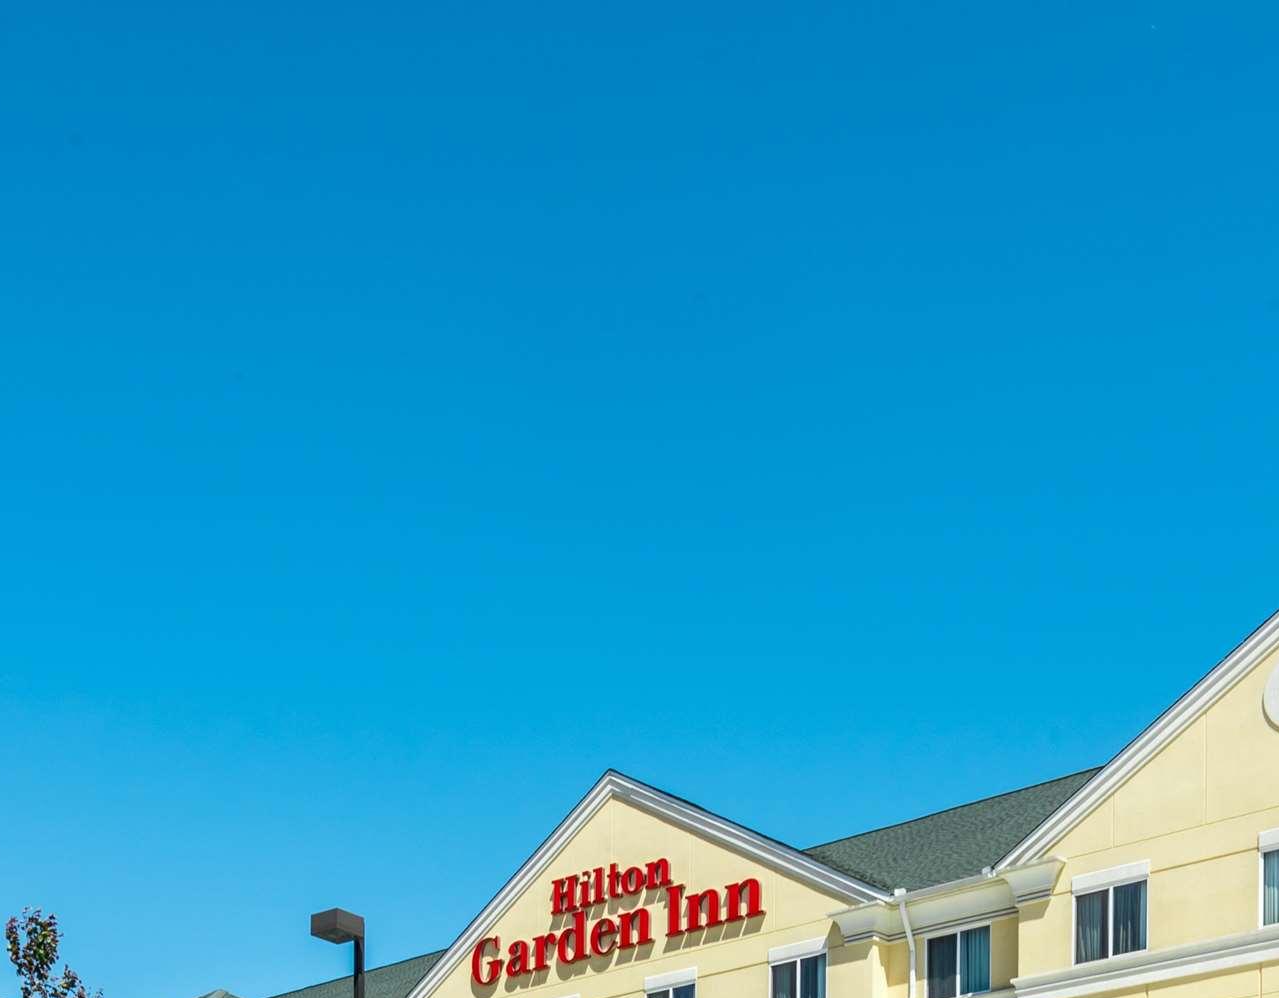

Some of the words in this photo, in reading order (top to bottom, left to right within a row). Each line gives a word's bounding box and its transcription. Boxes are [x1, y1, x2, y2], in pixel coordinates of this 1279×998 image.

[550, 857, 672, 916] Hilton
[471, 906, 655, 986] Garden
[665, 877, 766, 938] Inn
